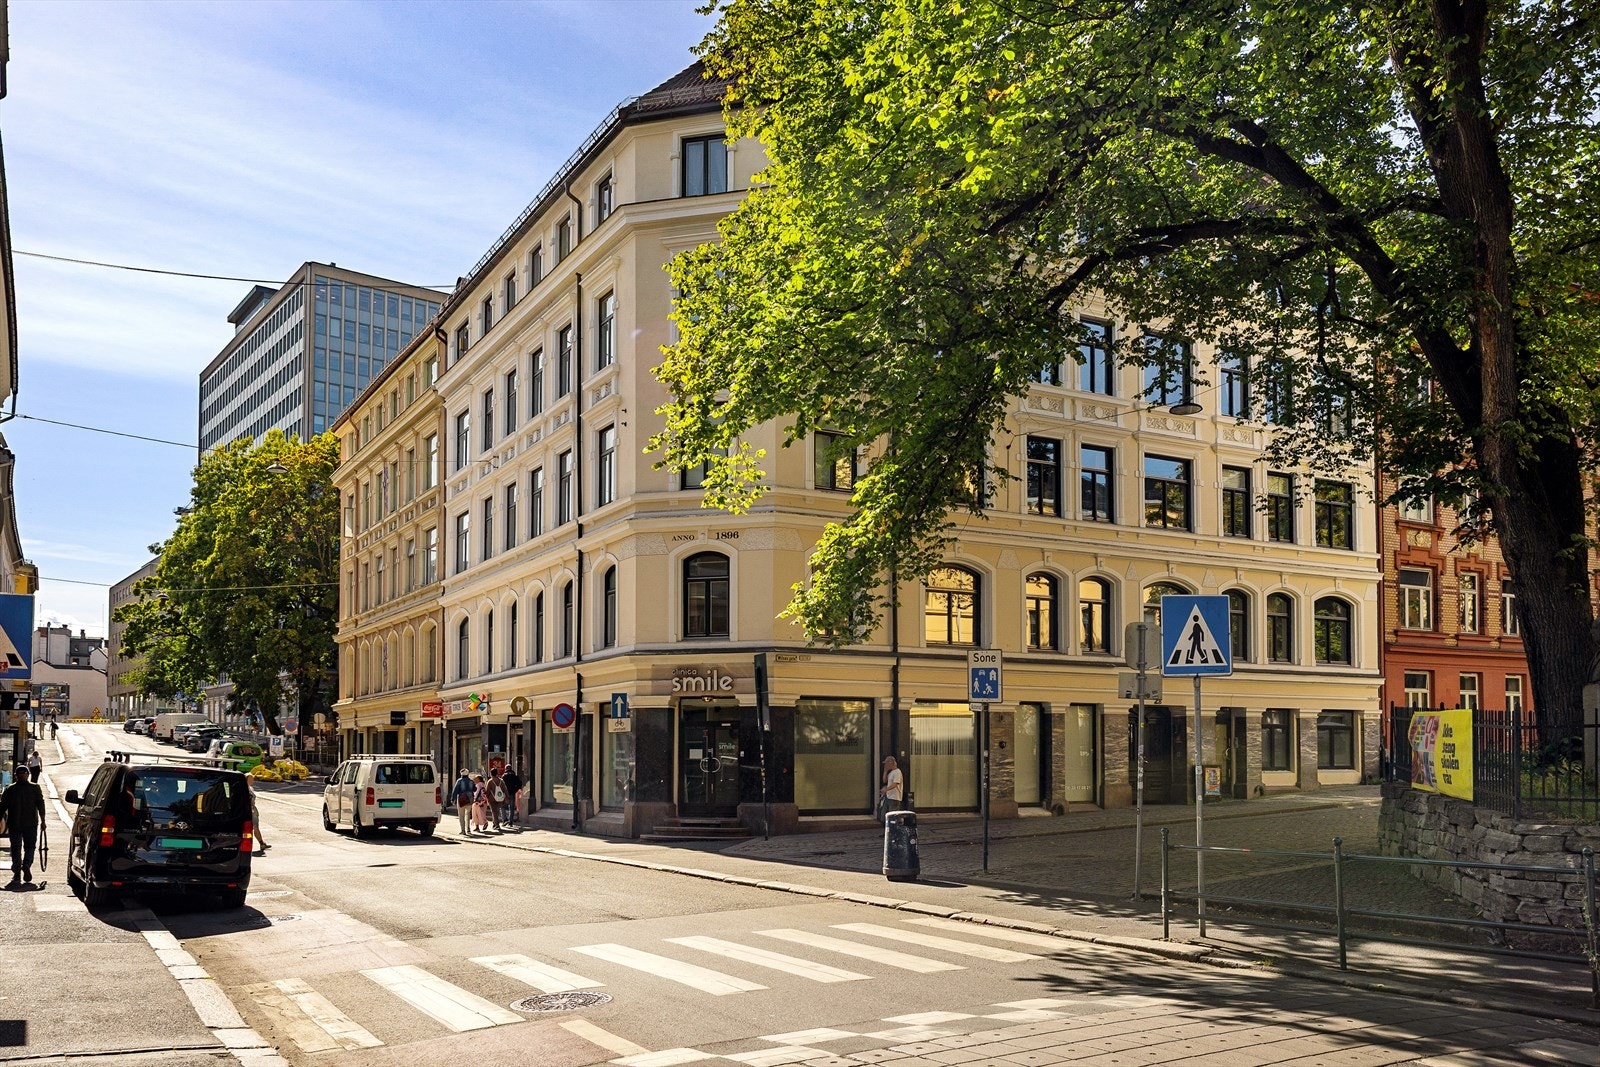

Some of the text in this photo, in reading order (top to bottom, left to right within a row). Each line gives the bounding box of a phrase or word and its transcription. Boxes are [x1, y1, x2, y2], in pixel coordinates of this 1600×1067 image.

[672, 531, 740, 542] ANNO 1896
[973, 652, 997, 663] Sone
[671, 668, 697, 676] clinica
[672, 669, 734, 692] smile
[718, 742, 736, 750] smile
[1440, 754, 1460, 771] skolen
